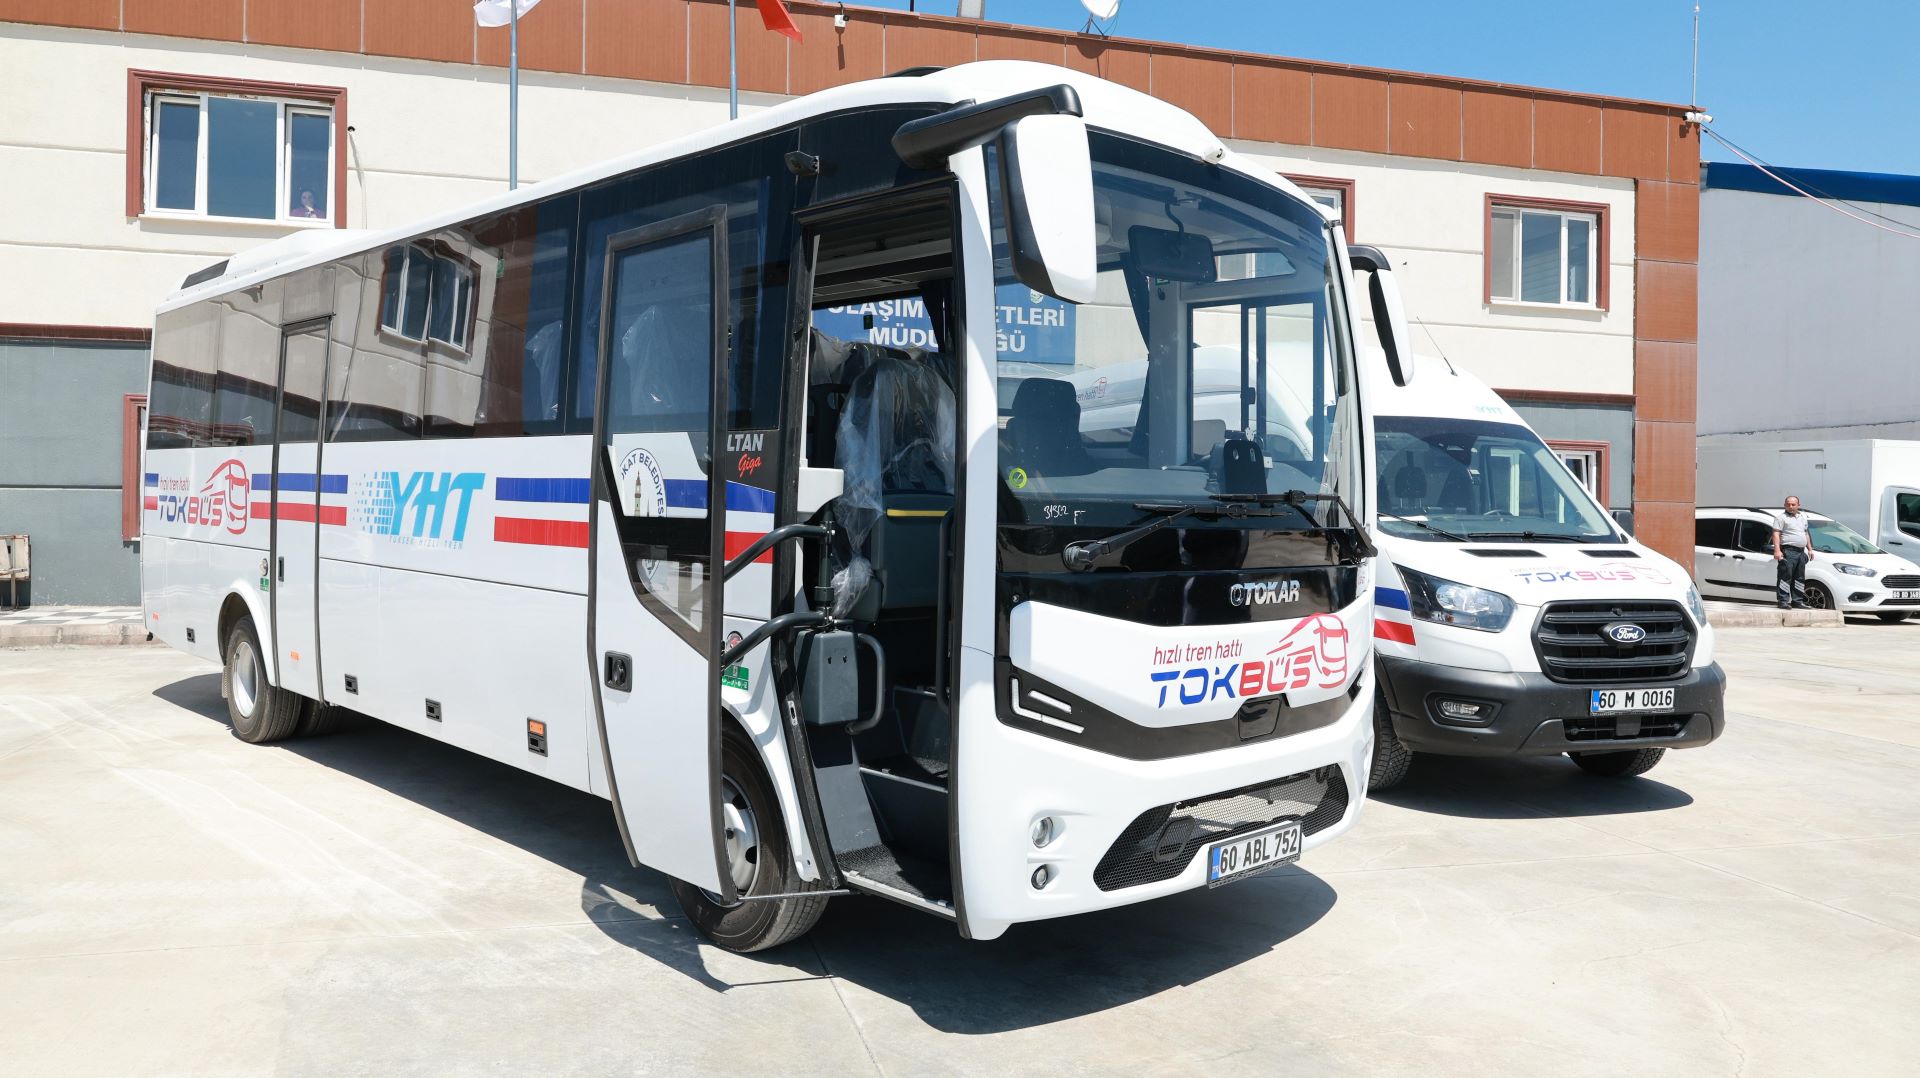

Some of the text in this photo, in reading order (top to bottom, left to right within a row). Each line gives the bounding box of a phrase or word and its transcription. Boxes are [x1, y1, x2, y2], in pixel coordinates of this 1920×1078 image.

[996, 305, 1065, 327] TLERİ
[738, 453, 762, 478] Giga
[621, 452, 665, 518] KAT BELEDİYES
[159, 494, 224, 526] TOKBÜS
[389, 471, 486, 542] YHT
[1230, 579, 1300, 607] OTOKAR
[1616, 627, 1640, 640] Ford
[1153, 639, 1243, 665] hızlı tren hattı
[1150, 654, 1313, 709] TOKBÜS
[1600, 692, 1616, 708] 60
[1624, 691, 1635, 708] M
[1642, 690, 1673, 707] 0016
[1220, 845, 1238, 874] 60
[1243, 837, 1271, 867] ABL
[1274, 828, 1298, 857] 752
